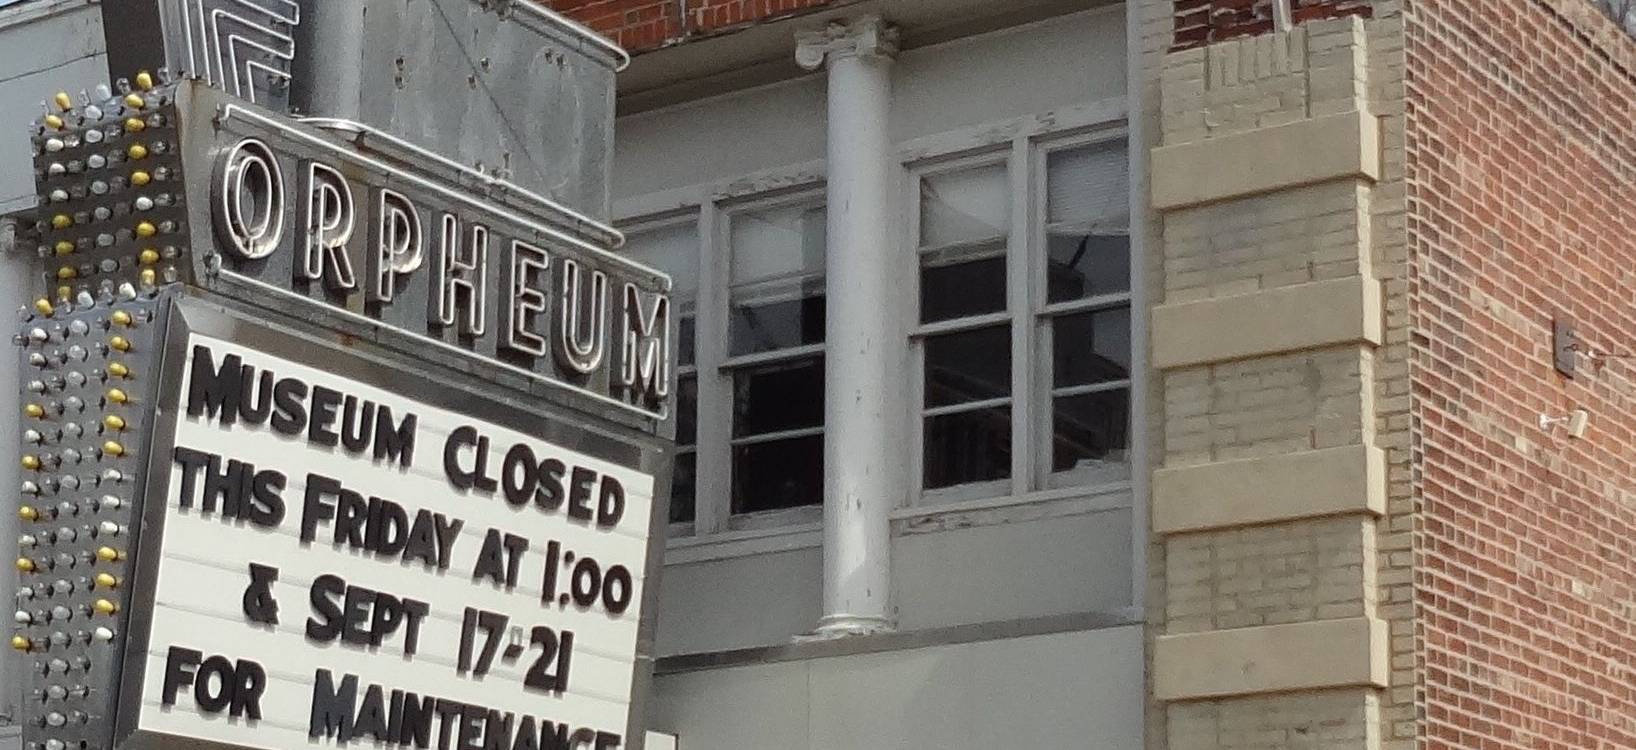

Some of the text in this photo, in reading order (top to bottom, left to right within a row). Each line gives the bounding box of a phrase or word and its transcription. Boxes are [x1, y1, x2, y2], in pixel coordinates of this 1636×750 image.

[210, 138, 671, 400] ORPHEUM
[187, 345, 625, 529] MUSEUM CLOSED
[174, 446, 633, 614] THIS FRIDAY AT 1:00
[162, 645, 266, 721] FOR
[243, 562, 574, 694] & SEPT 17-21
